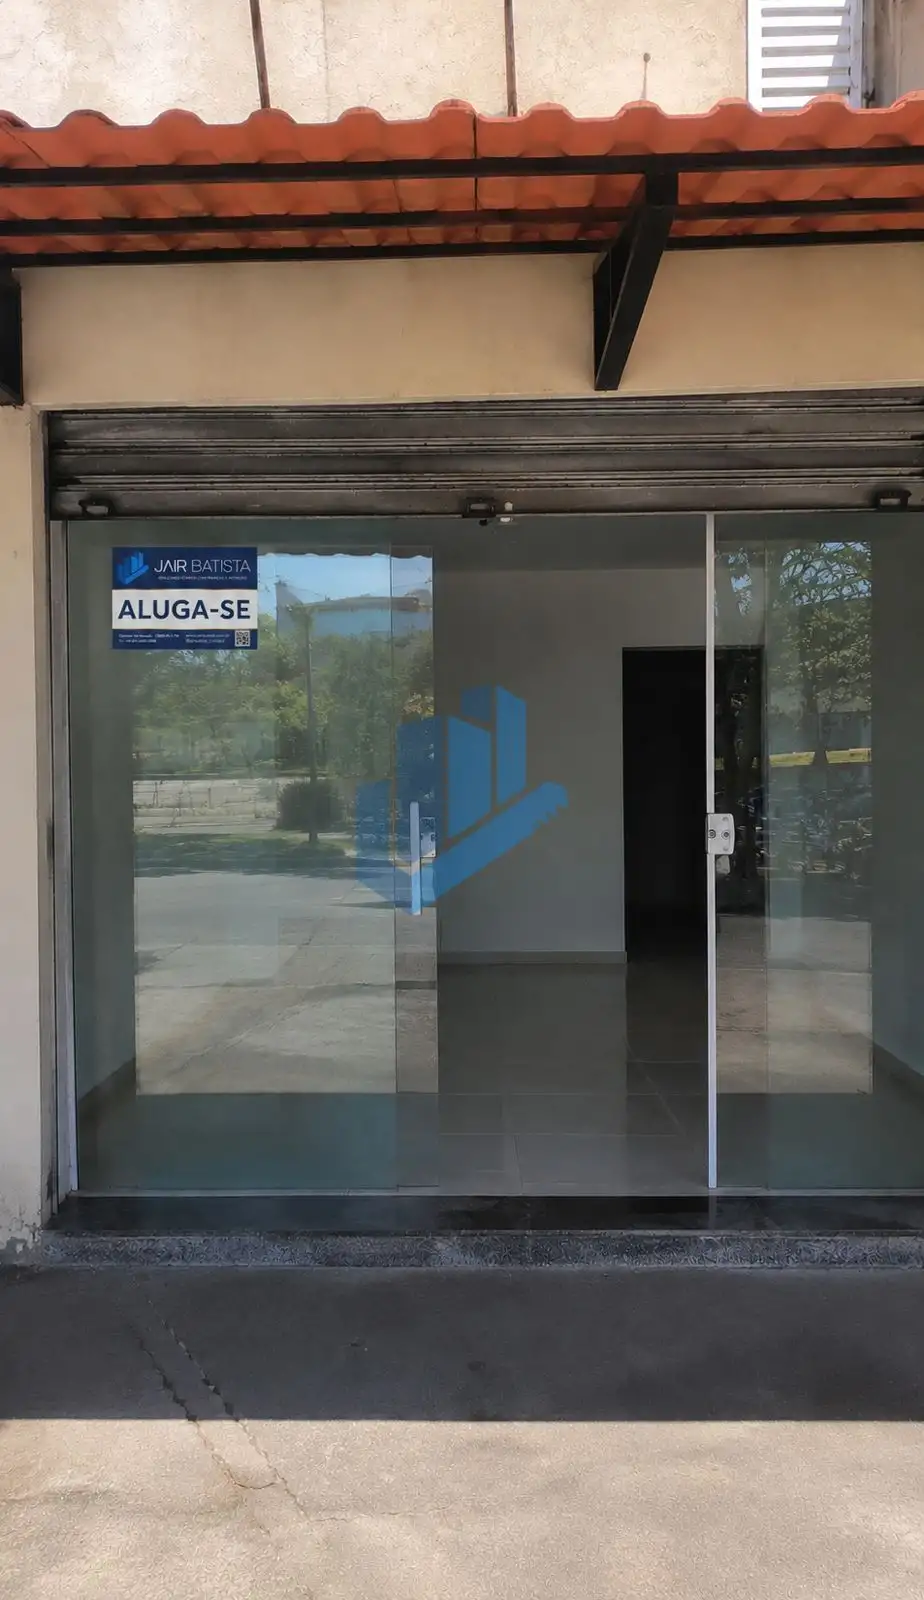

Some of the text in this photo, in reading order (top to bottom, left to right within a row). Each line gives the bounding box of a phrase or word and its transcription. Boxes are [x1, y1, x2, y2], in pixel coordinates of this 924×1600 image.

[154, 560, 251, 573] JAIR BATISTA
[118, 600, 251, 620] ALUGA-SE
